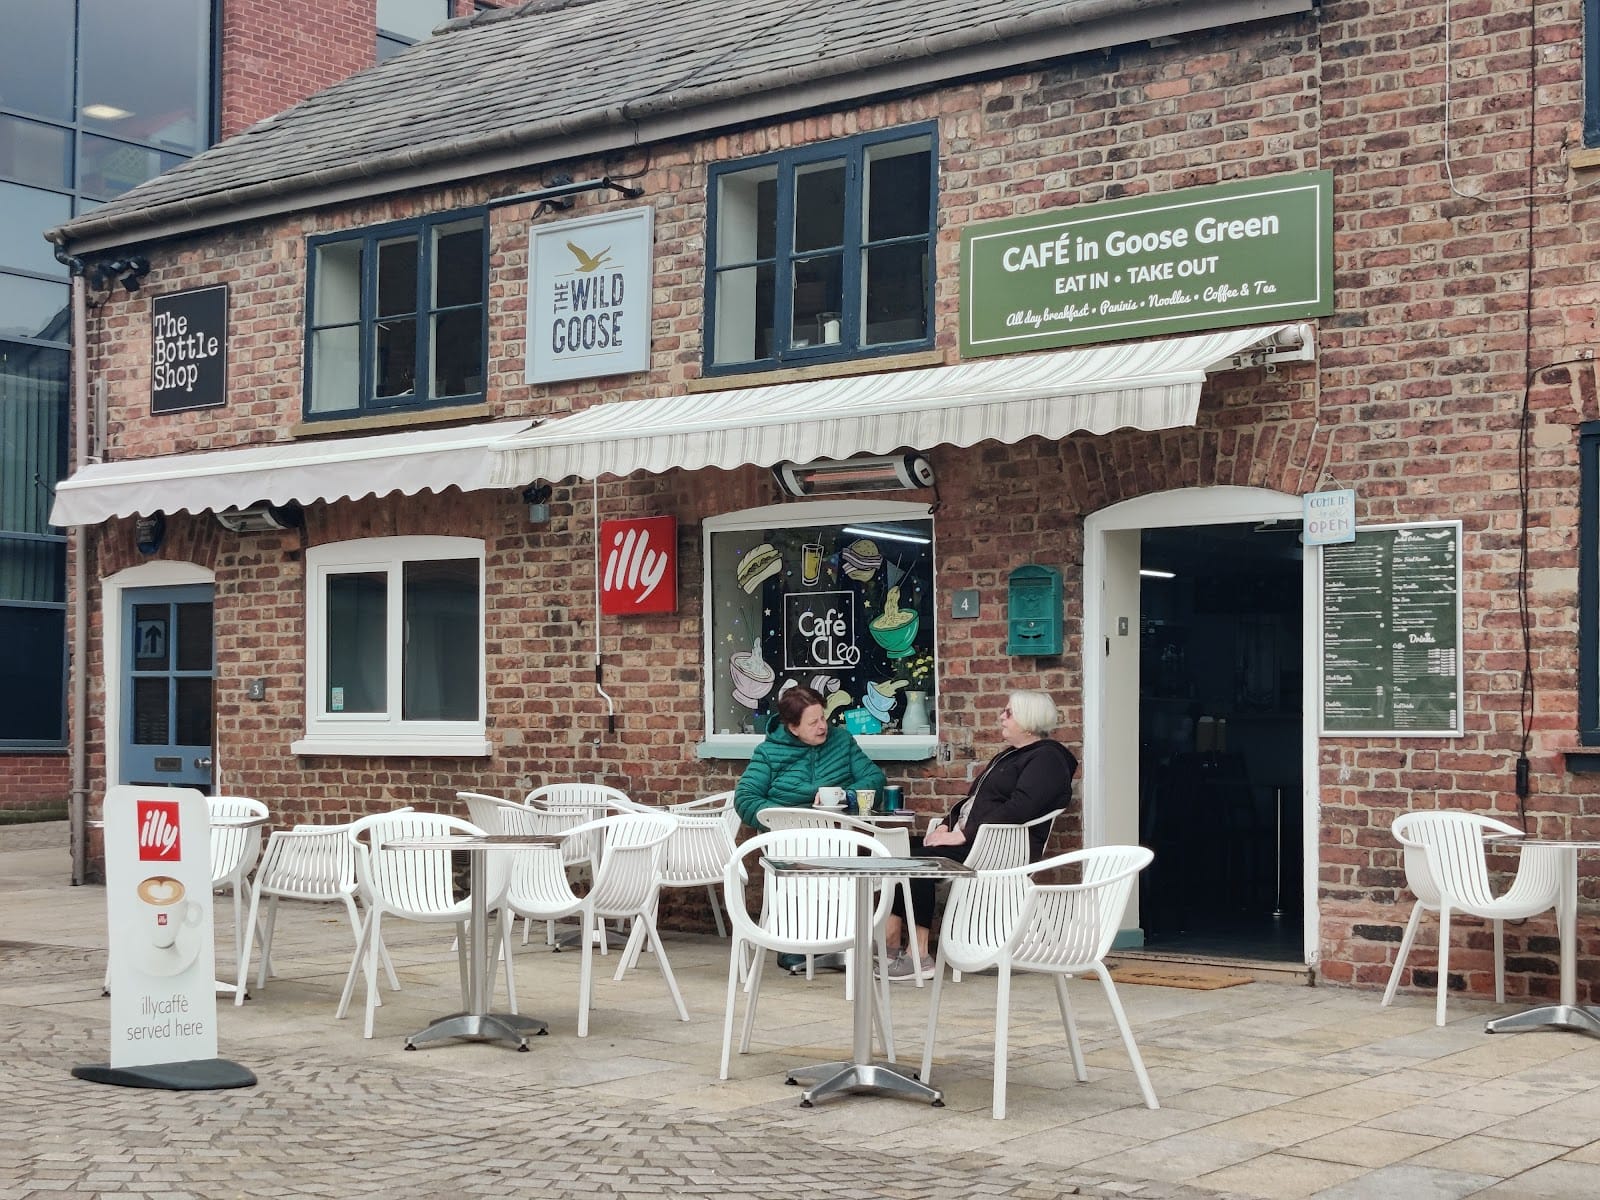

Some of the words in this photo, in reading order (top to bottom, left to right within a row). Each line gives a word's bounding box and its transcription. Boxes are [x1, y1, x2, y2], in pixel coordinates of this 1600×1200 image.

[1002, 232, 1070, 272] CAFÉ
[1076, 236, 1099, 262] in
[1105, 228, 1188, 257] Goose
[1195, 215, 1280, 243] Green
[1055, 274, 1087, 295] EAT
[1089, 271, 1109, 290] IN
[1127, 262, 1174, 285] TAKE
[1177, 255, 1220, 277] OUT
[553, 281, 569, 315] THE
[570, 273, 625, 312] WILD
[1006, 310, 1023, 327] All
[1024, 310, 1042, 329] day
[1043, 303, 1089, 322] breakfast
[1100, 299, 1138, 316] Paninis
[1148, 290, 1192, 308] Noodles
[1203, 284, 1240, 303] Coffee
[1240, 283, 1250, 297] &
[1253, 280, 1277, 295] Tea
[155, 312, 188, 340] The
[552, 310, 624, 354] GOOSE
[154, 332, 219, 365] Bottle
[153, 363, 198, 392] Shop
[1309, 518, 1349, 534] OPEN
[603, 527, 668, 604] illy
[960, 598, 969, 611] 4
[798, 608, 847, 637] Café
[253, 685, 260, 695] 3
[141, 809, 178, 856] illy
[127, 1018, 171, 1041] served
[175, 1016, 204, 1037] here
